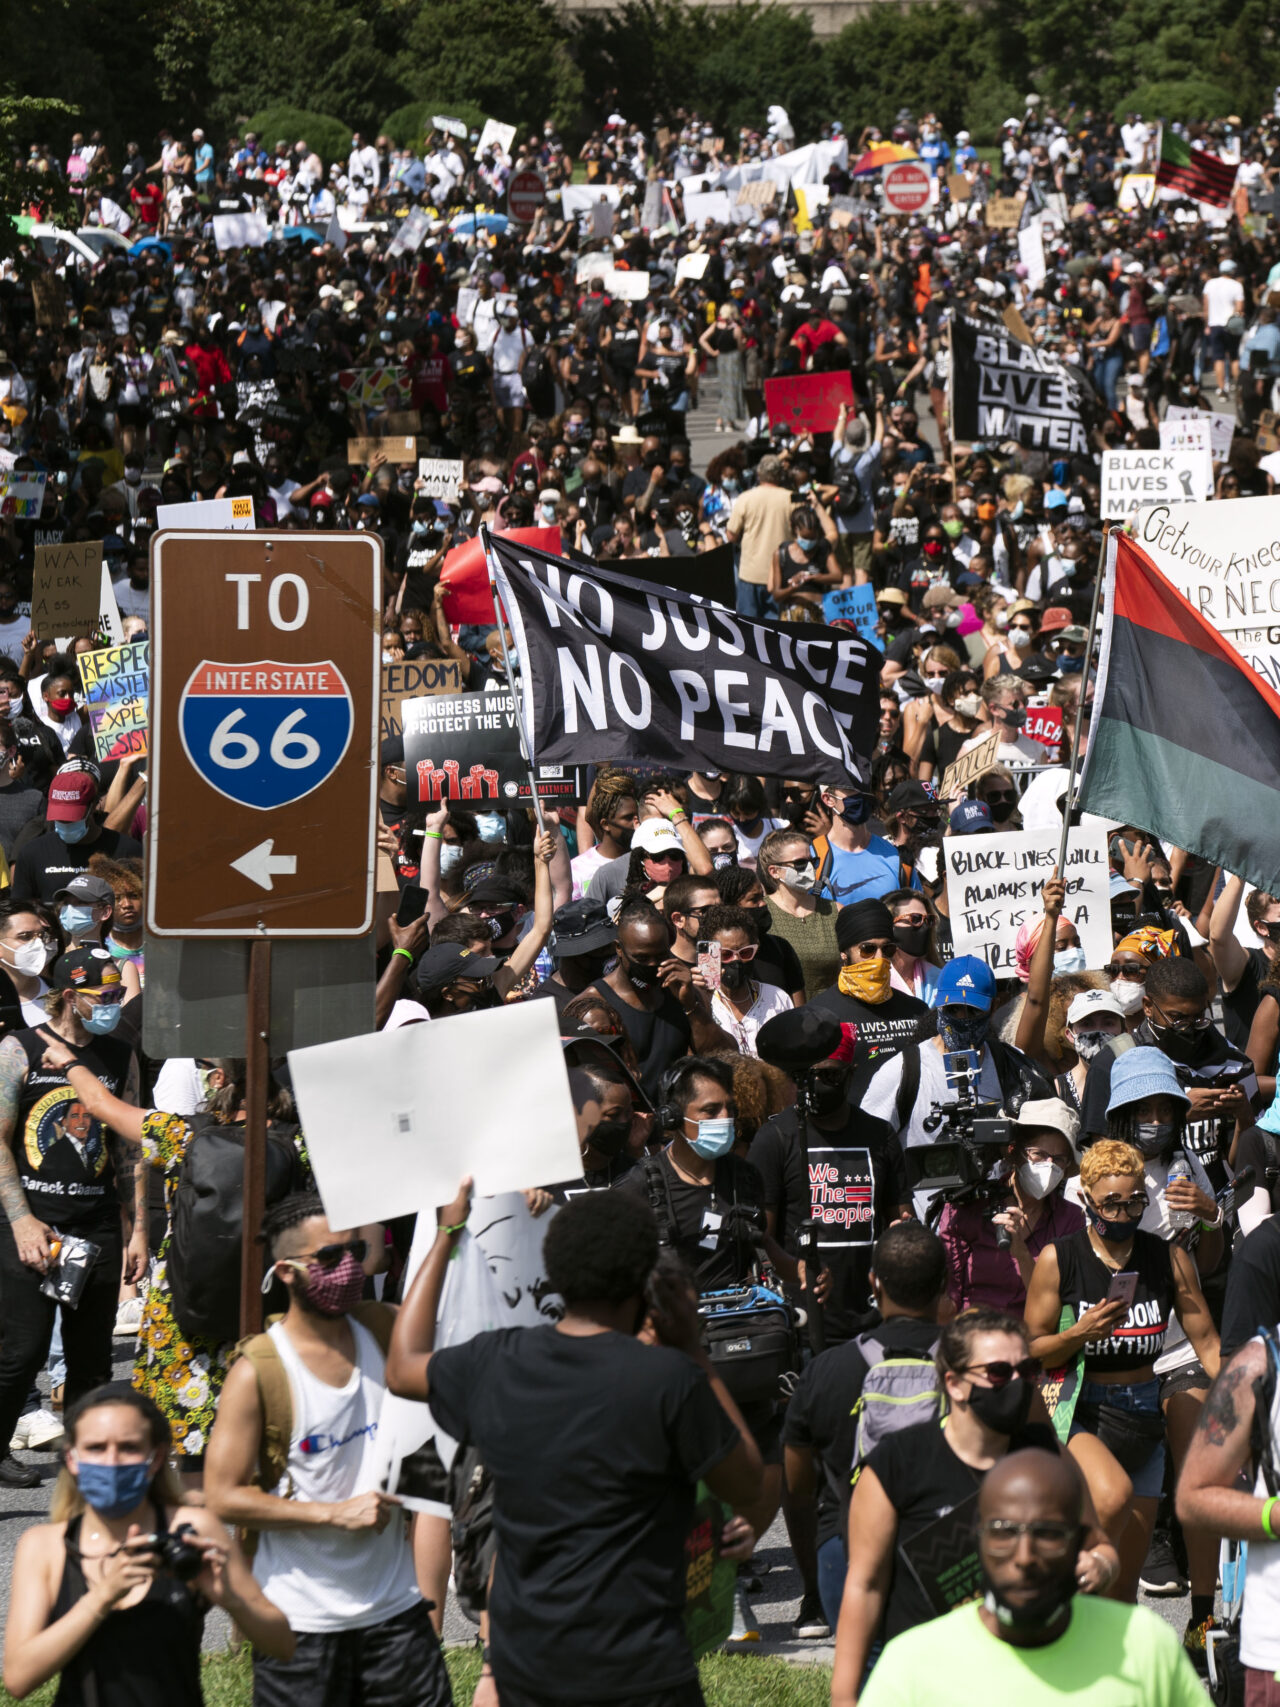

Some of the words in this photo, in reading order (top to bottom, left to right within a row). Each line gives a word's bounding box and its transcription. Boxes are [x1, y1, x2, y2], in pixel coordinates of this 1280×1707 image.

[978, 404, 1089, 455] MATTER
[1108, 456, 1175, 471] BLACK
[1108, 476, 1168, 491] LIVES
[233, 508, 251, 517] NOW
[234, 502, 249, 510] OUT
[34, 529, 64, 545] BLACK
[1143, 506, 1189, 556] Get
[41, 575, 82, 590] WEAK
[225, 573, 309, 632] TO
[831, 591, 854, 605] GET
[838, 603, 873, 617] YOUR
[518, 560, 614, 637] NO
[642, 590, 868, 695] JUSTICE
[206, 672, 329, 691] INTERSTATE
[121, 694, 139, 707] OR
[92, 705, 146, 733] EXPE
[411, 715, 471, 735] PROTECT
[475, 713, 501, 730] THE
[557, 644, 652, 734] NO
[668, 669, 863, 784] PEACE
[209, 708, 321, 770] 66
[1017, 717, 1063, 743] EACH
[519, 784, 574, 796] COMITMENT
[45, 865, 91, 874] #Christophe
[950, 850, 1010, 876] BLACK
[1014, 848, 1057, 871] LIVES
[1064, 847, 1105, 866] WILL
[964, 880, 1028, 907] ALWAYS
[1031, 876, 1094, 898] MER
[960, 909, 1003, 933] THIS
[1009, 910, 1026, 926] IS
[1074, 904, 1090, 925] A
[975, 942, 1017, 970] TRE
[861, 1020, 888, 1033] LIVES
[29, 1089, 73, 1128] PRESIDENT
[808, 1163, 839, 1183] We
[22, 1175, 65, 1195] Barack
[68, 1182, 105, 1196] Obama
[809, 1183, 845, 1203] The
[811, 1203, 872, 1230] People
[1077, 1299, 1162, 1328] FDOM
[1084, 1332, 1168, 1356] ERYTHIN
[1041, 1383, 1064, 1397] ACK
[299, 1421, 378, 1454] Champ
